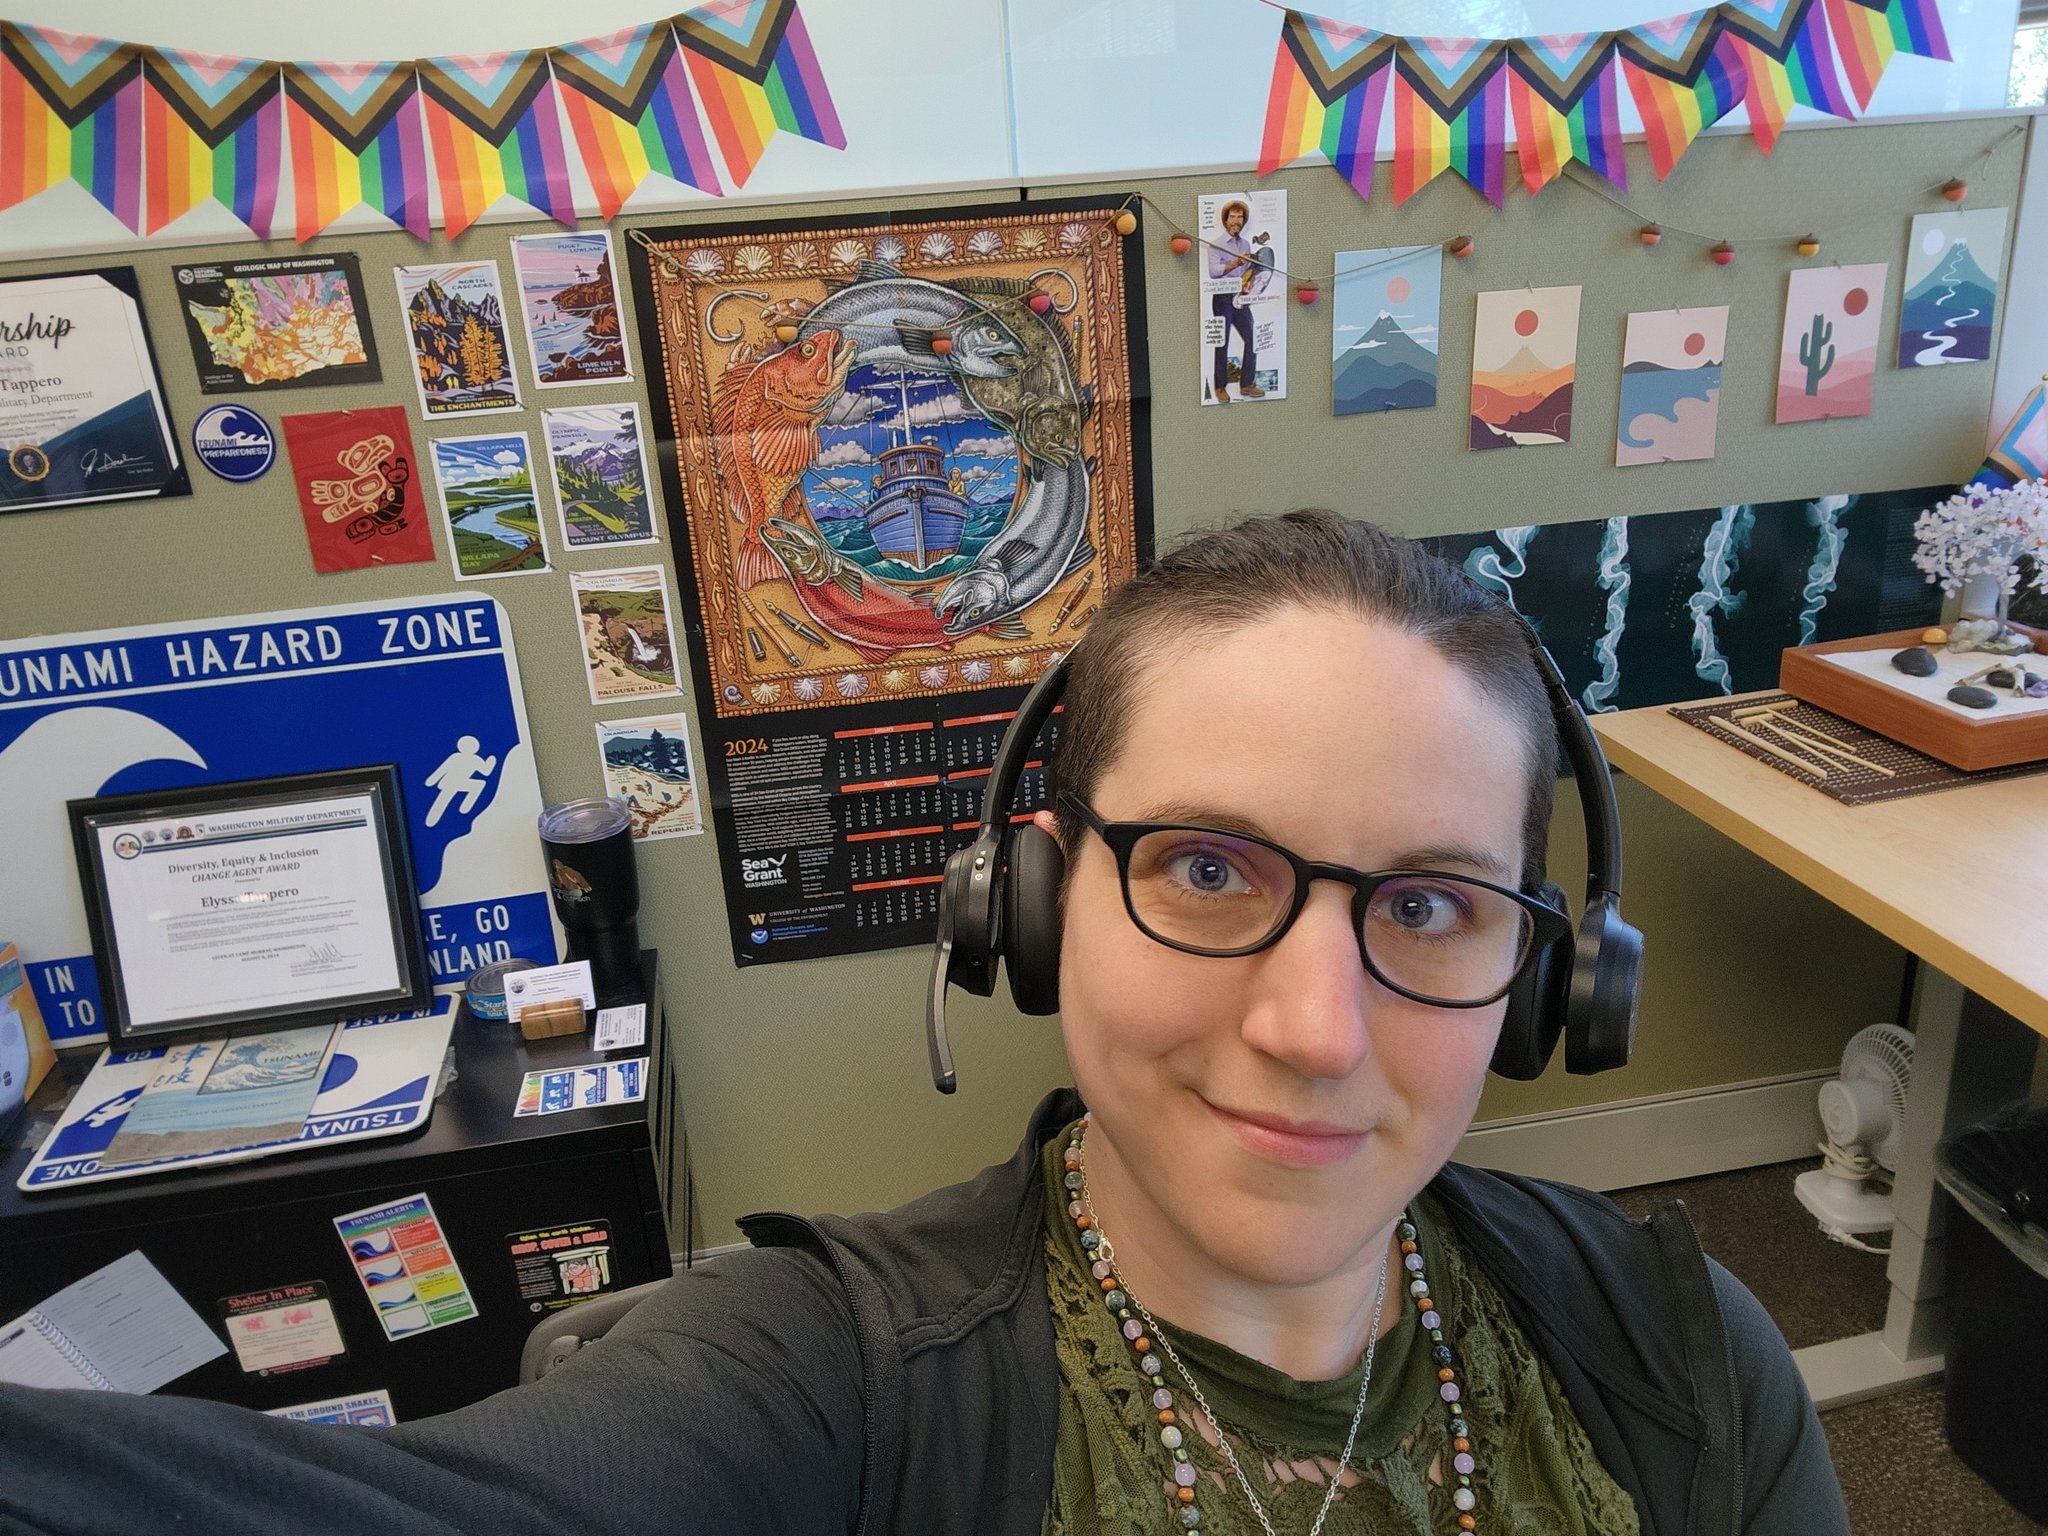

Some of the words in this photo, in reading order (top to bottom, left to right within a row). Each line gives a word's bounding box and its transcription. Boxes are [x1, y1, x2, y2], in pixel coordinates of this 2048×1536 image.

[234, 264, 267, 272] GEOLOGIC
[292, 259, 335, 268] WASHINGTON
[577, 361, 600, 369] LIME
[585, 366, 614, 374] POINT
[1, 377, 62, 393] Tappero
[31, 391, 94, 405] Department
[430, 404, 446, 412] THE
[447, 399, 515, 411] ENCHANTMENTS
[198, 439, 237, 448] TSUNAMI
[204, 447, 268, 458] PREPAREDNESS
[571, 536, 604, 544] MOUNT
[607, 531, 651, 541] OLYMPUS
[461, 552, 500, 561] WILLAPA
[167, 624, 343, 679] HAZARD
[378, 608, 491, 655] ZONE
[598, 687, 636, 696] PALOUSE
[724, 738, 769, 756] 2024
[208, 823, 264, 833] WASHINGTON
[266, 816, 305, 827] MILITARY
[306, 808, 362, 821] DEPARTMENT
[651, 825, 695, 835] REPUBLIC
[168, 860, 219, 874] Diversity,
[221, 855, 256, 867] Equity
[258, 853, 267, 862] &
[269, 848, 319, 861] Inclusion
[741, 858, 769, 870] Sea
[191, 870, 231, 883] CHANGE
[232, 866, 264, 878] AGENT
[266, 862, 301, 874] AWARD
[743, 867, 783, 881] Grant
[744, 878, 788, 888] WASHINGTON
[244, 887, 299, 903] Tpero
[769, 909, 801, 917] UNIVERSITY
[809, 903, 846, 912] WASHINGTON
[748, 912, 766, 926] W
[44, 965, 76, 994] IN
[425, 913, 457, 943] E,
[475, 904, 510, 934] GO
[59, 999, 96, 1028] TO
[300, 1111, 405, 1139] TSUNA
[350, 1212, 385, 1226] TSUNAMI
[385, 1203, 415, 1216] ALERTS
[540, 1236, 572, 1250] COVER
[227, 1294, 268, 1309] Shelter
[269, 1291, 282, 1301] In
[284, 1285, 314, 1297] Place
[290, 1410, 305, 1418] THE
[307, 1403, 344, 1415] GROUND
